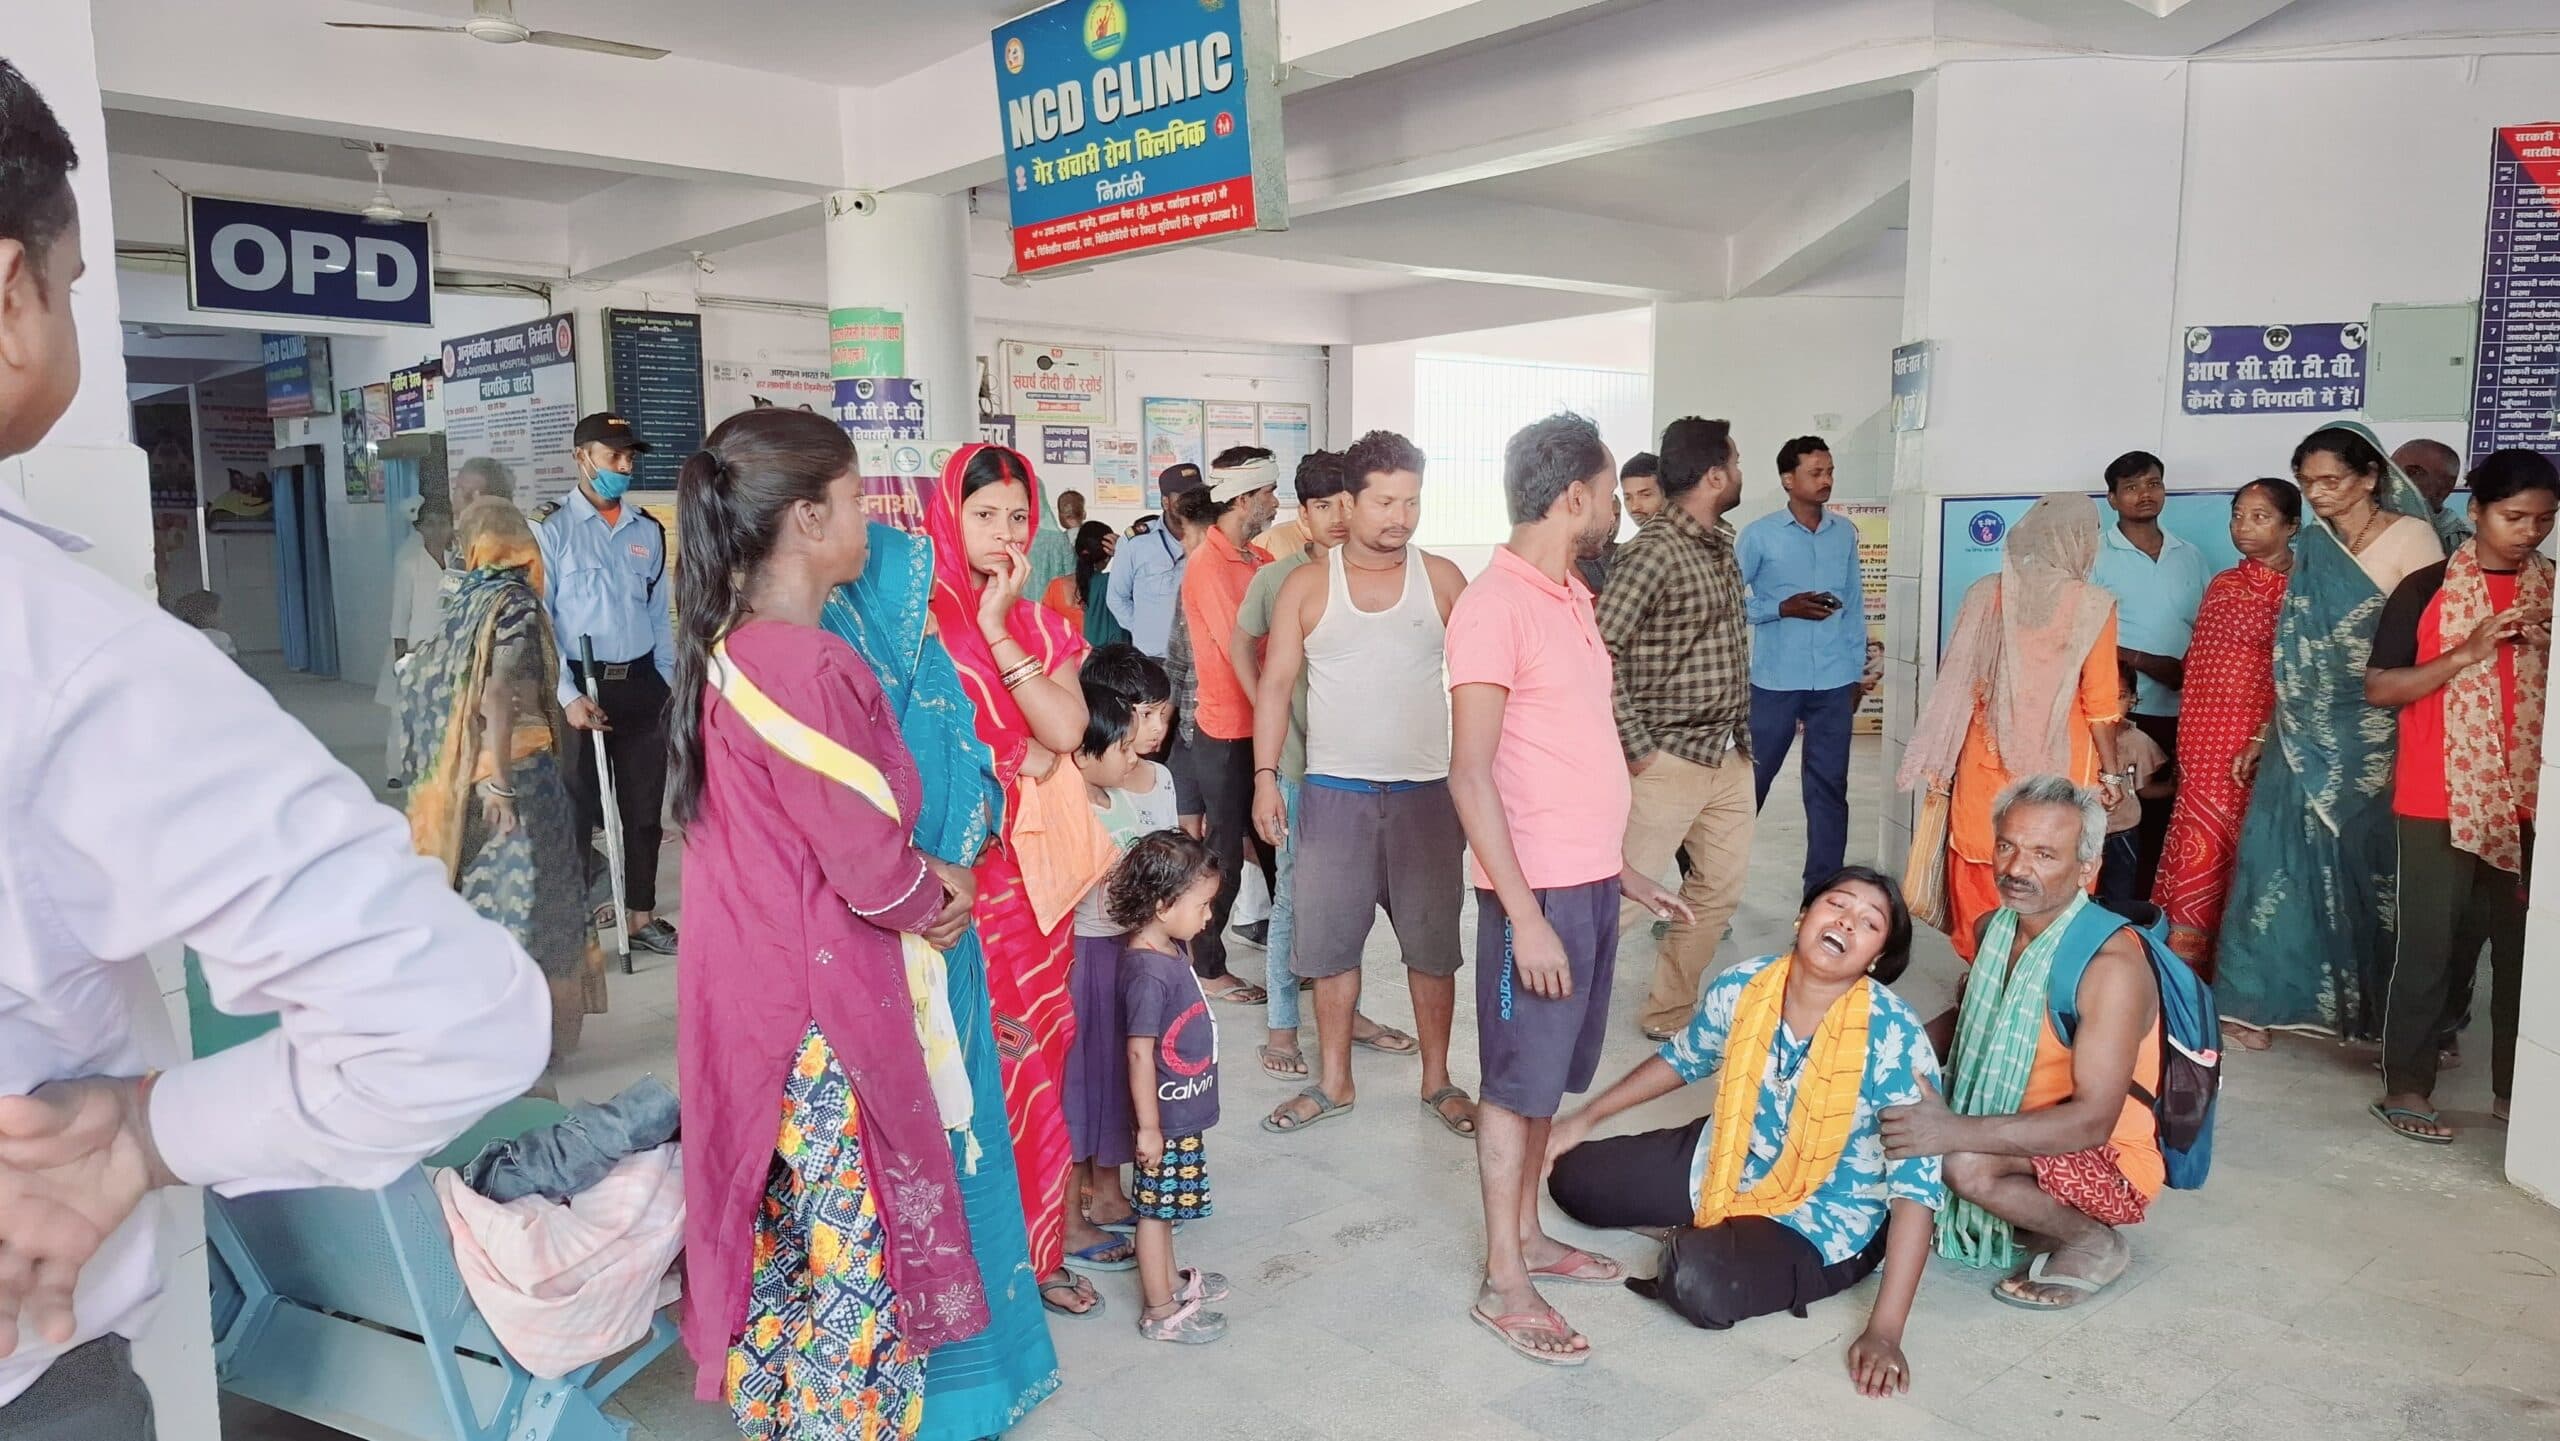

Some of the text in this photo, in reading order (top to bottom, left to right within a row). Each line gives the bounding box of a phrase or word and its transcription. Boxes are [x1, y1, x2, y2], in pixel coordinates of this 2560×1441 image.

[1008, 31, 1235, 149] NCD CLINIC
[2516, 131, 2554, 142] सरकारी
[1032, 157, 1055, 187] गैर
[1057, 142, 1101, 183] संचारी
[1103, 136, 1132, 169] रोग
[1096, 171, 1146, 203] निर्मली
[210, 223, 418, 302] OPD
[2495, 258, 2502, 266] 4
[2494, 281, 2500, 289] 5
[280, 335, 308, 361] CLINIC
[456, 362, 499, 378] SUB-DIVISIONAL
[530, 352, 556, 365] NIRMALI
[2188, 353, 2361, 384] आप सी.सी.टी.वी.
[2187, 387, 2225, 410] कैमरे
[2229, 388, 2248, 409] के
[2252, 386, 2317, 408] निगरानी
[2320, 385, 2338, 407] में
[2482, 396, 2494, 404] 10
[2480, 418, 2490, 426] 11
[2478, 441, 2489, 449] 12
[1158, 1072, 1214, 1101] Calvin
